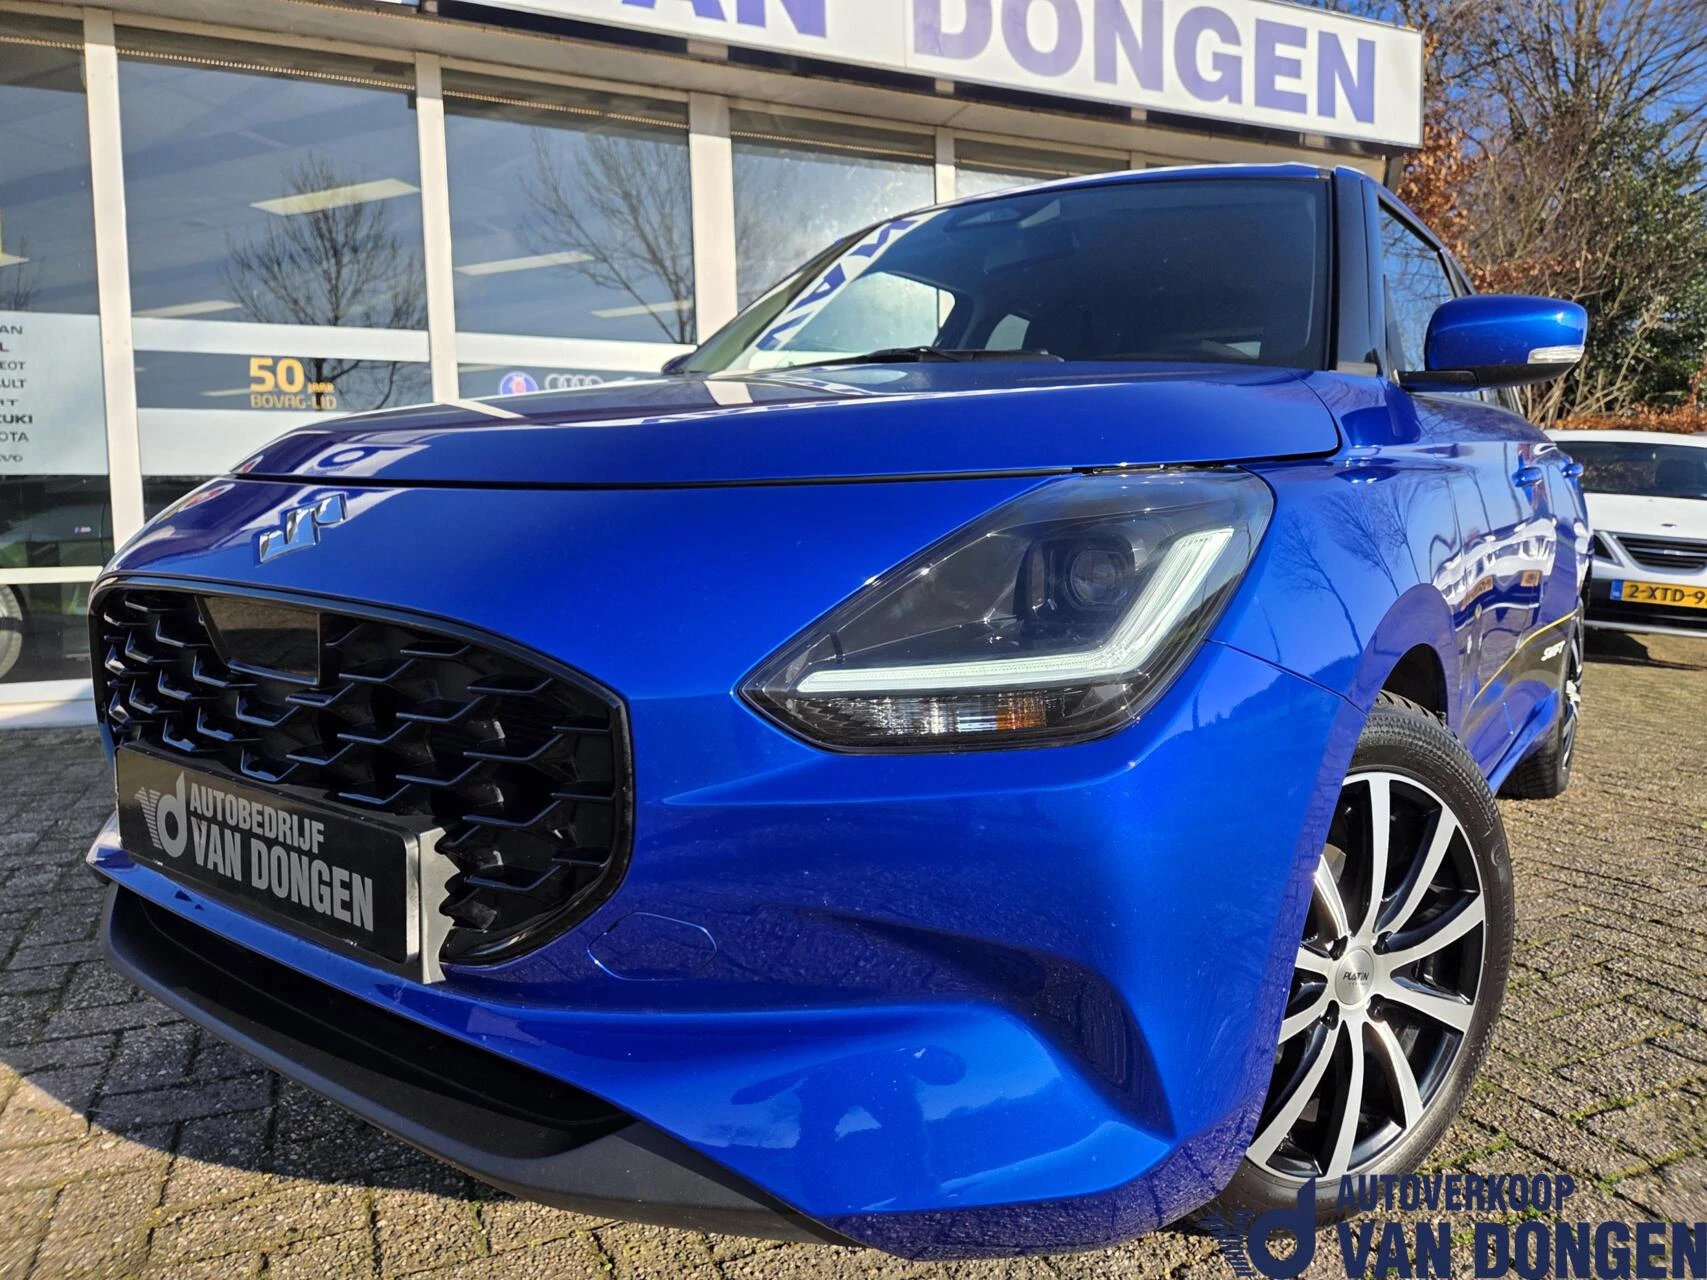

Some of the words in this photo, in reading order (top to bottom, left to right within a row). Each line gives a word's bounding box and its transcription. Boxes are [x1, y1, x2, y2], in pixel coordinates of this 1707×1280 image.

[914, 0, 1376, 125] DONGEN
[250, 357, 305, 394] 50
[250, 395, 337, 410] BOVAG-LID
[1629, 584, 1707, 604] 2-XTD-9
[190, 782, 325, 854] AUTOBEDRIJF
[190, 815, 242, 882] VAN
[251, 837, 374, 932] DONGEN
